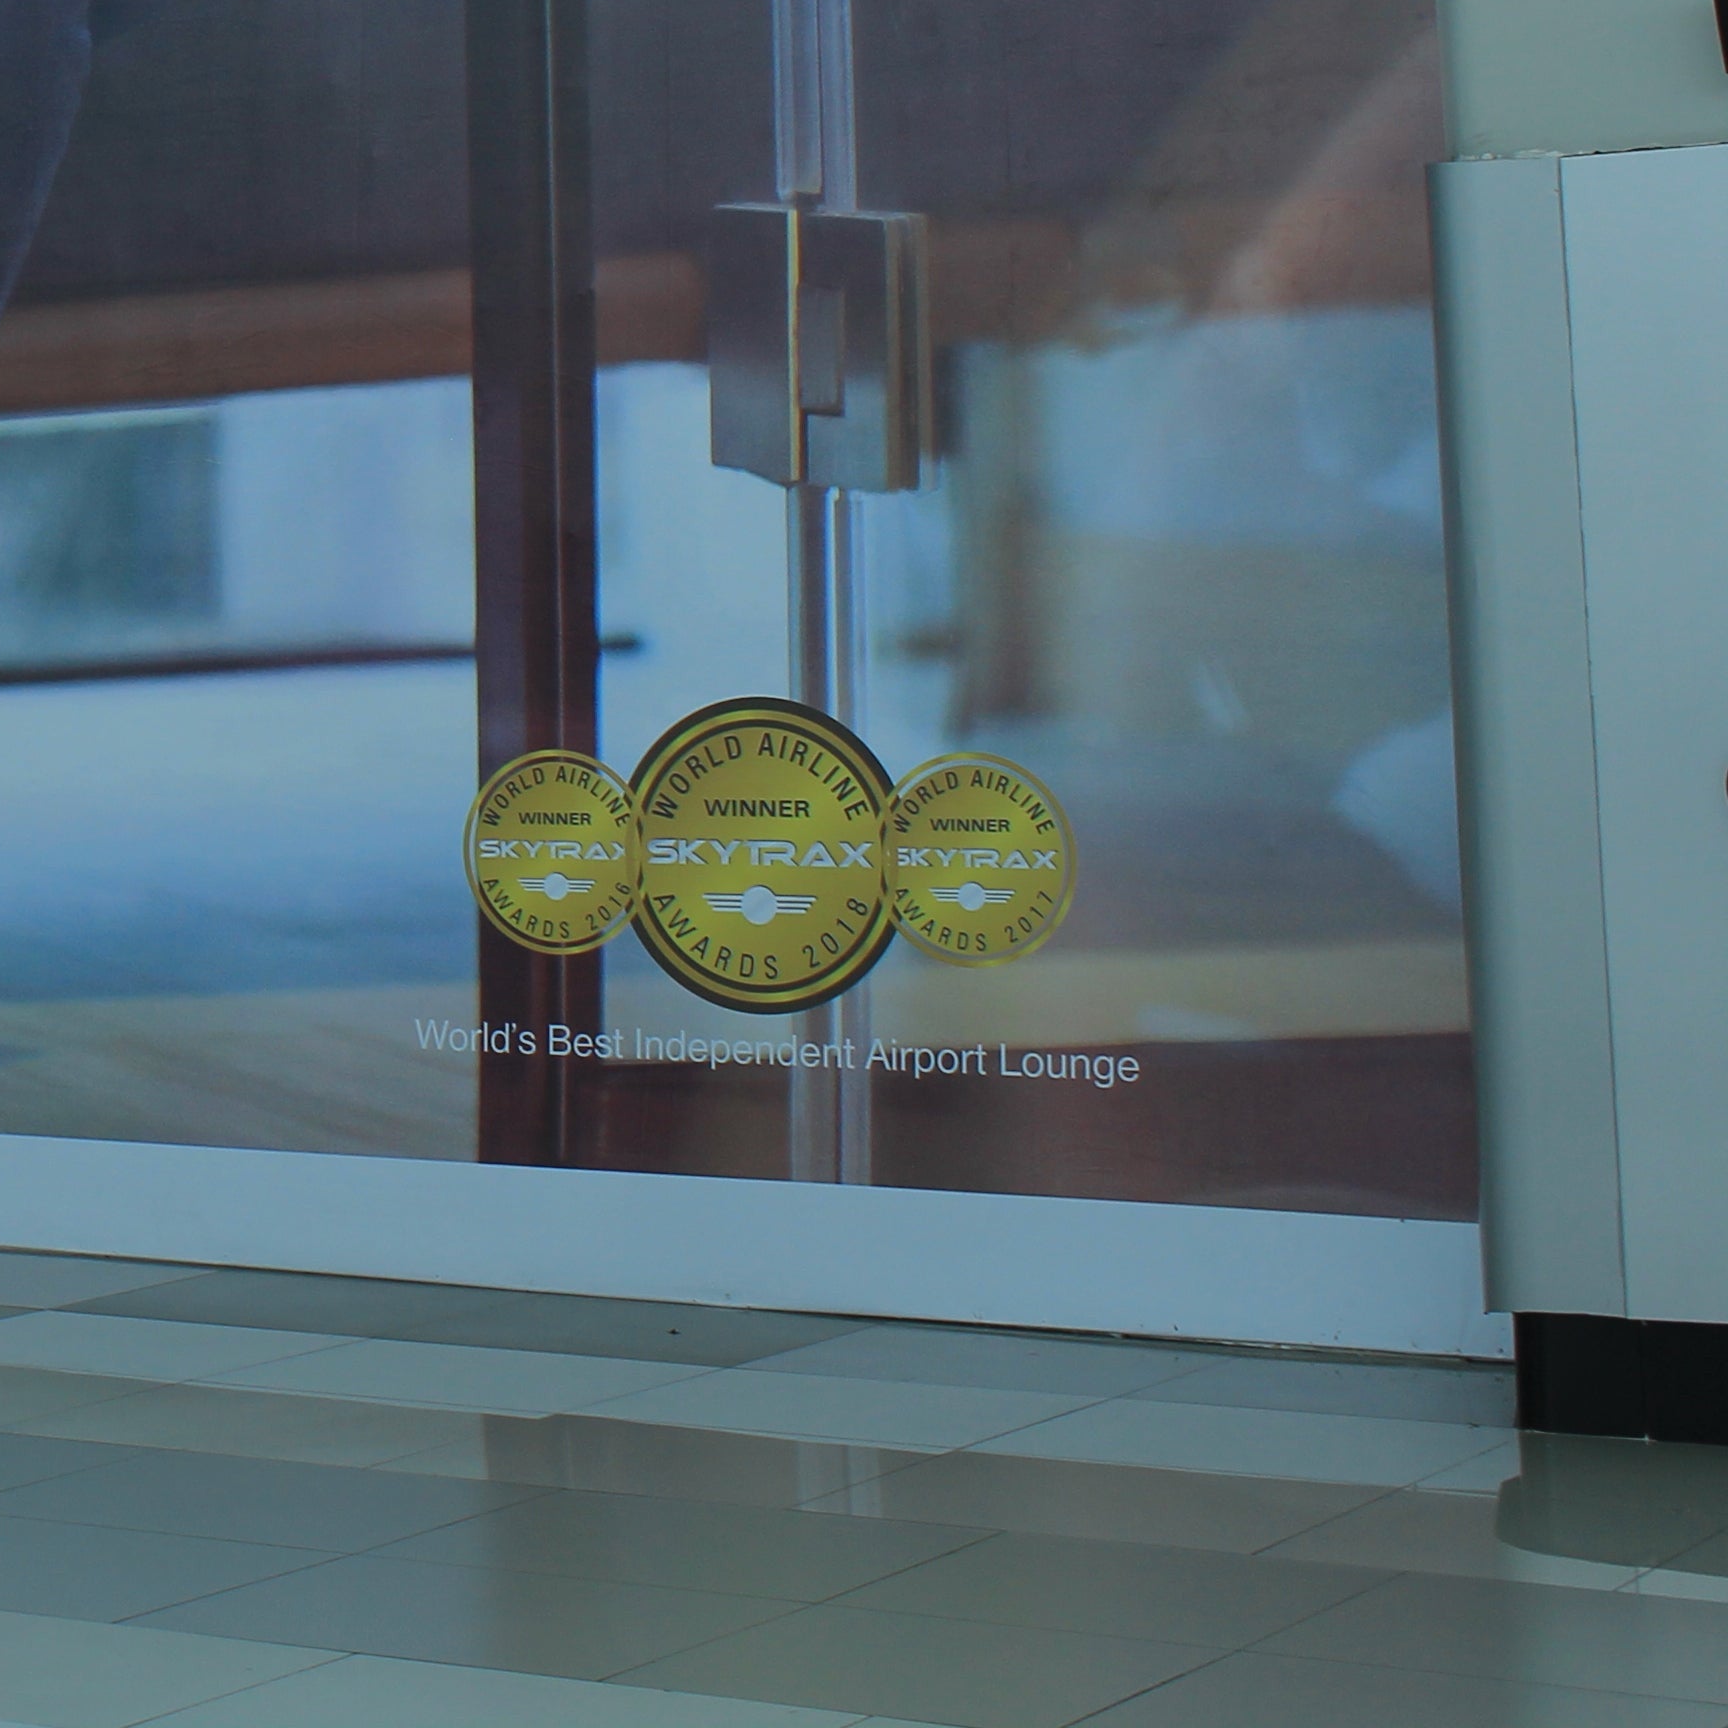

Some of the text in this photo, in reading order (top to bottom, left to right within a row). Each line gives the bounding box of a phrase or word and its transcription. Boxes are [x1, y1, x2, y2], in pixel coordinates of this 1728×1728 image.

[482, 765, 631, 828] WORLD AIRLINE
[652, 732, 869, 821] WORLD AIRLINE
[893, 770, 1055, 835] WORLD AIRLINE
[519, 812, 591, 826] WINNER
[704, 799, 811, 818] WINNER
[930, 819, 1011, 833] WINNER
[647, 837, 874, 868] SKYTRAX
[484, 878, 631, 939] AWARDS 2016
[653, 893, 868, 979] AWARDS 2018
[895, 887, 987, 952] AWARDS
[414, 1018, 1140, 1089] World's Best Independent Airport Lounge
